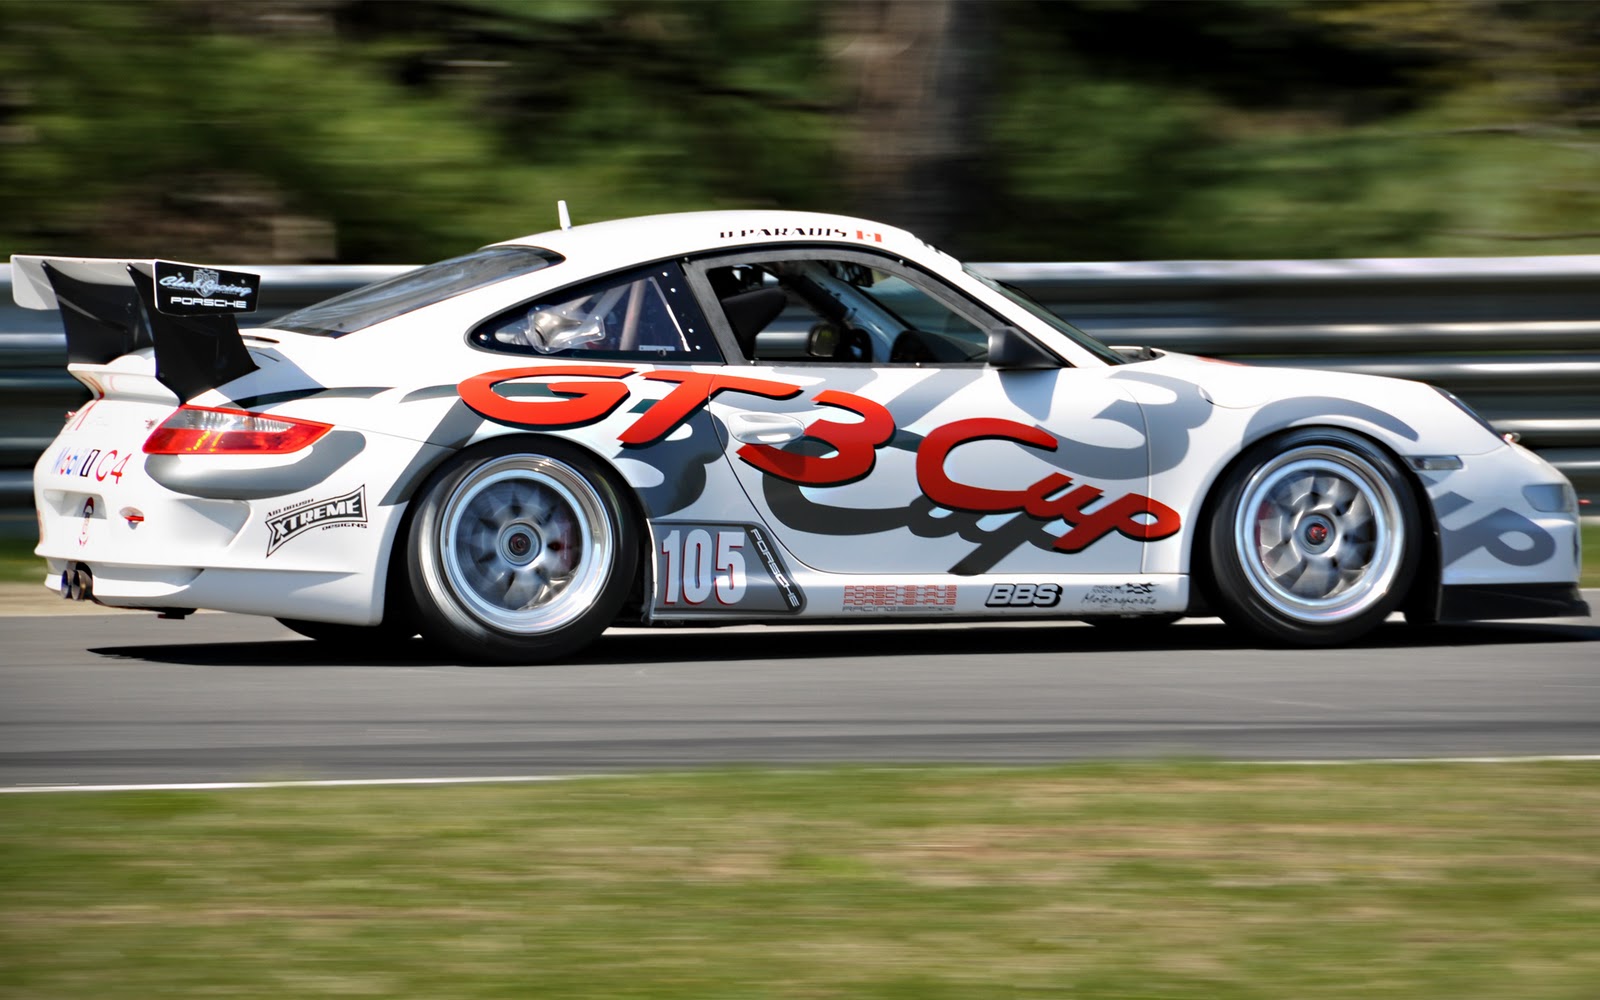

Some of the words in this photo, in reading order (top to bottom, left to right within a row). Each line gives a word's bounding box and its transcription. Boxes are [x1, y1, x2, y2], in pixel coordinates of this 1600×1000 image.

[170, 296, 247, 309] PORSCHE
[915, 416, 1182, 555] Cup
[272, 495, 361, 541] XTREME
[661, 528, 748, 606] 105
[750, 528, 800, 608] PORSCHE
[984, 583, 1064, 607] BBS
